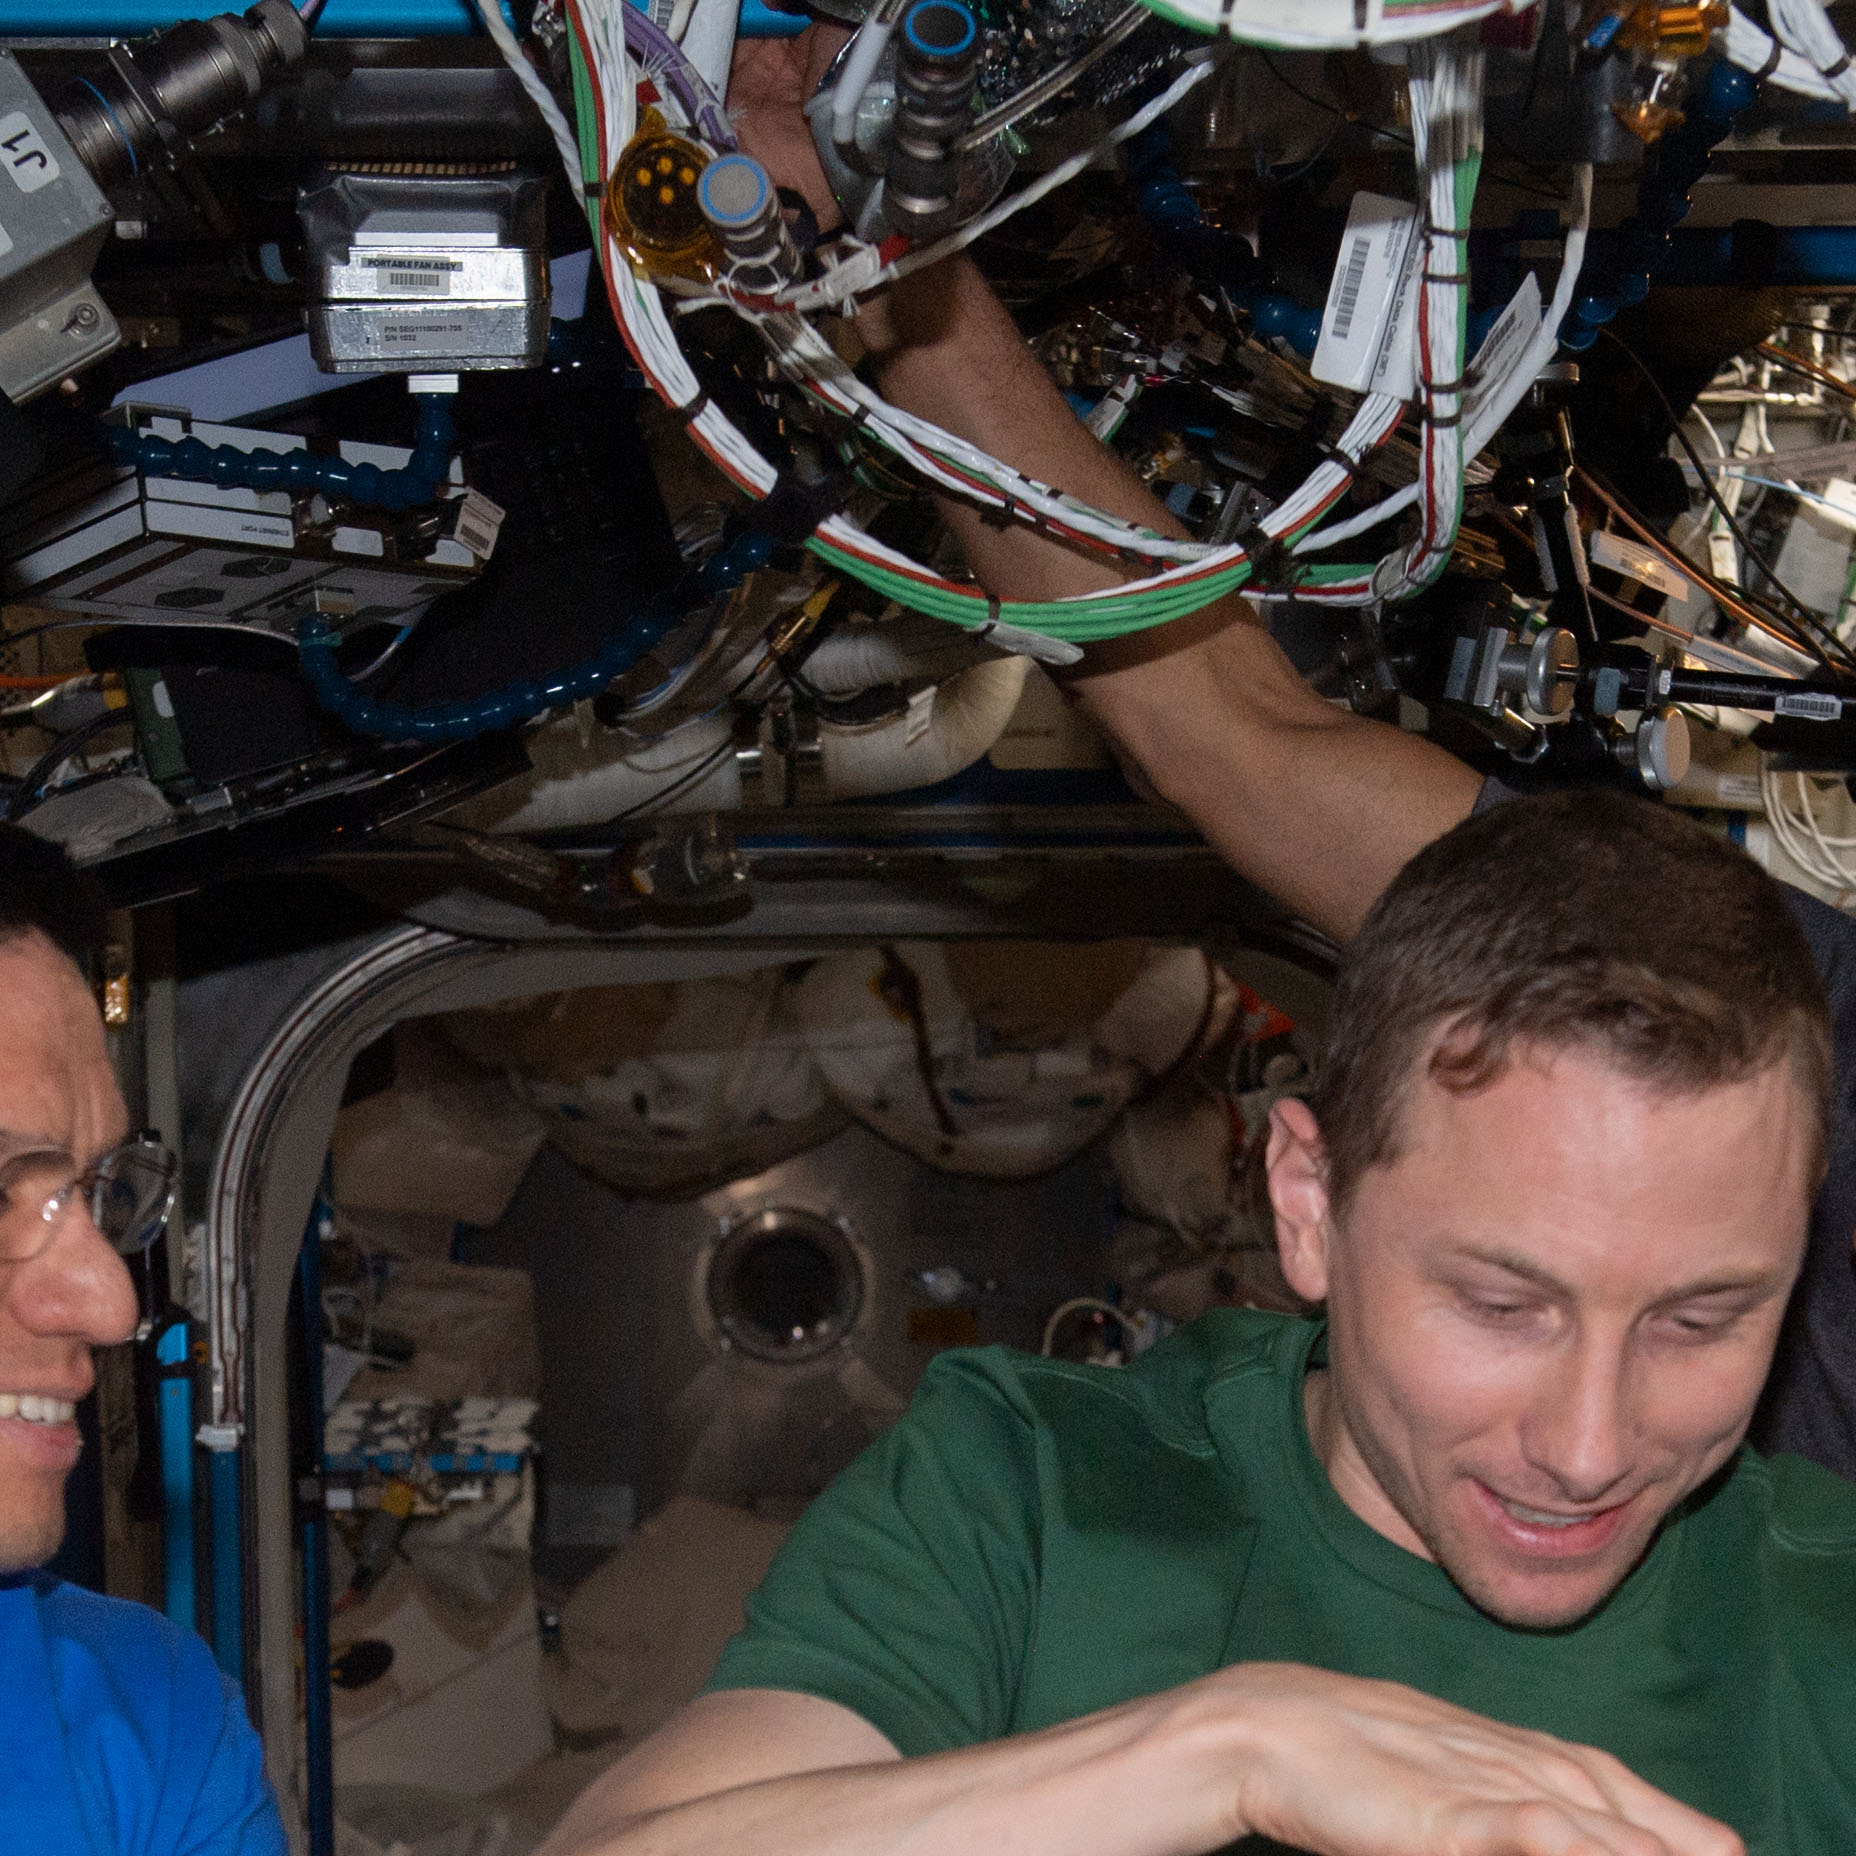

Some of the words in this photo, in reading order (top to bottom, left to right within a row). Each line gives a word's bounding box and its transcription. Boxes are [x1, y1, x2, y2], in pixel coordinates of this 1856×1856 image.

[0, 129, 47, 169] J1
[367, 258, 413, 269] PORTABLE
[414, 261, 432, 270] FAN
[433, 262, 457, 271] ASSY
